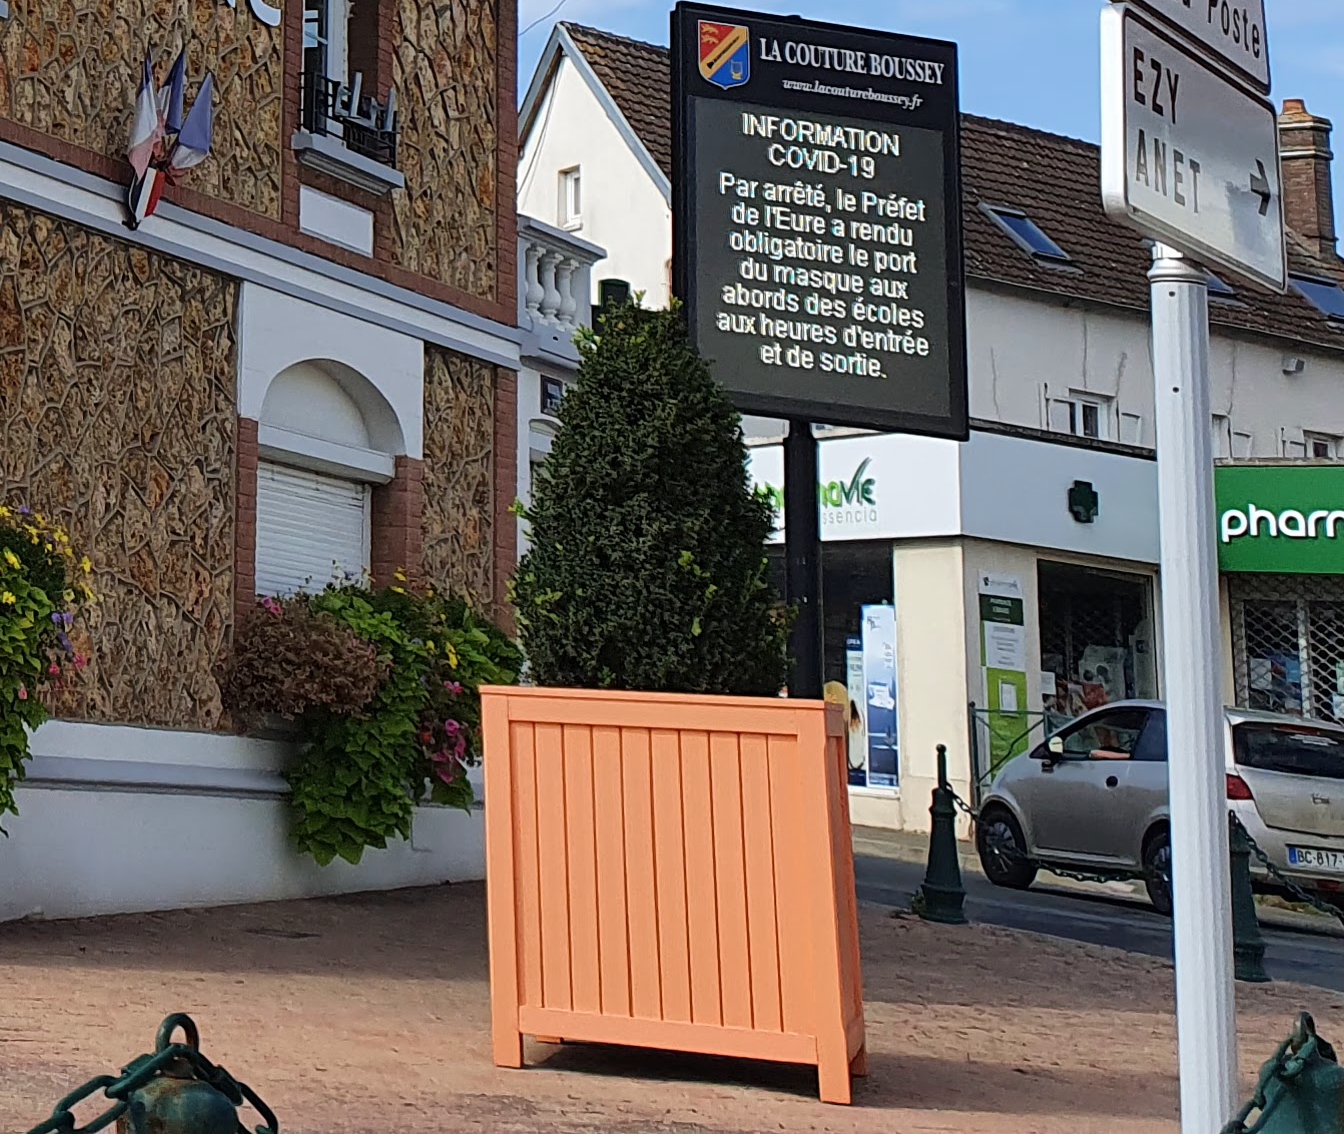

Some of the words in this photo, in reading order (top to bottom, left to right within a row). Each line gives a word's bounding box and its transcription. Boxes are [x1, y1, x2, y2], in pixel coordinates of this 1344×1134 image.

[759, 37, 783, 62] LA
[785, 41, 867, 74] COUTURE
[869, 53, 944, 85] BOUSSEY
[782, 79, 923, 110] www.lacoutureboussey.fr
[1133, 46, 1179, 125] EZY
[741, 112, 901, 157] INFORMATION
[768, 143, 876, 179] COVID-19
[1135, 128, 1201, 214] ANET
[719, 171, 759, 198] Par
[763, 180, 832, 214] arrêté,
[836, 187, 857, 212] le
[862, 191, 926, 222] Préfet
[731, 202, 760, 226] de
[764, 205, 826, 234] l'Eure
[831, 218, 846, 237] a
[850, 222, 913, 247] rendu
[729, 228, 843, 264] obligatoire
[848, 242, 869, 267] le
[874, 250, 918, 274] port
[739, 257, 768, 281] du
[773, 265, 864, 295] masque
[869, 277, 909, 300] aux
[722, 282, 800, 312] abords
[804, 293, 847, 319] des
[851, 297, 925, 329] écoles
[716, 311, 757, 335] aux
[760, 312, 838, 345] heures
[843, 324, 930, 357] d'entrée
[760, 342, 783, 366] et
[786, 344, 814, 369] de
[819, 352, 888, 379] sortie.
[822, 507, 878, 525] ssencia
